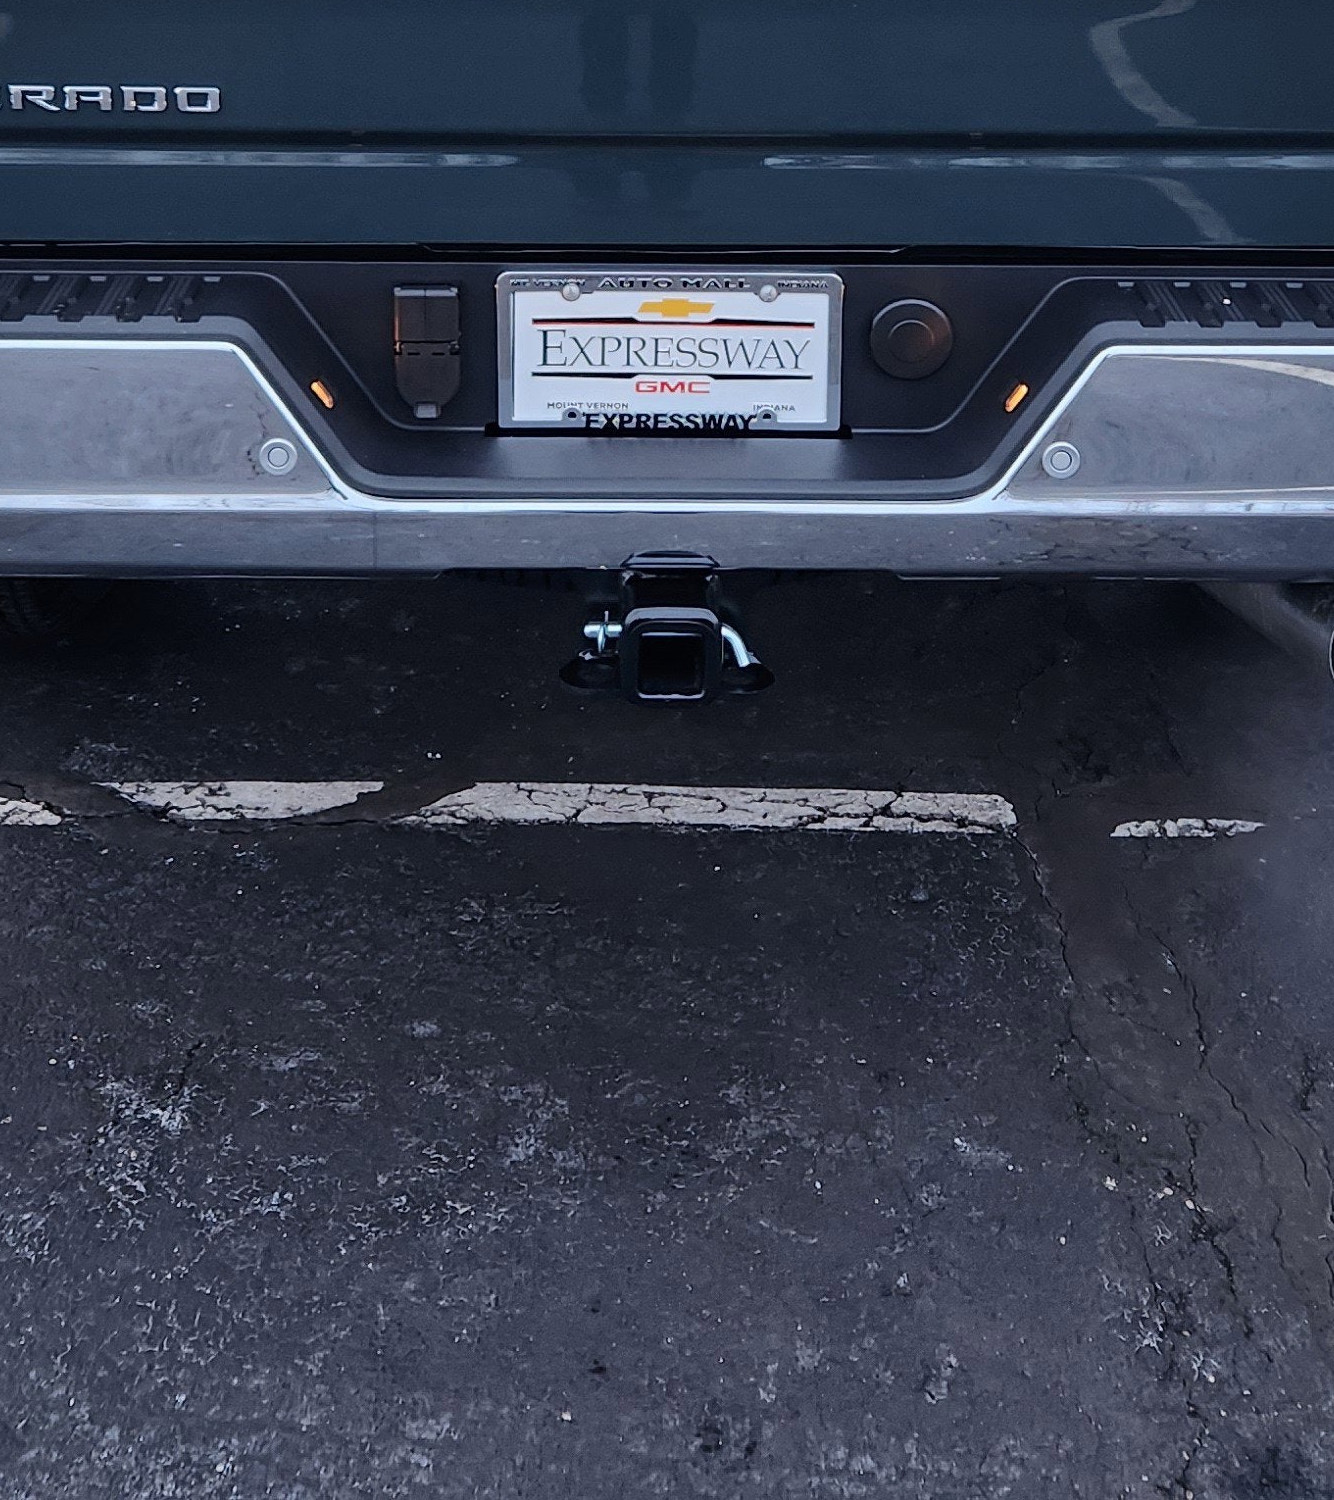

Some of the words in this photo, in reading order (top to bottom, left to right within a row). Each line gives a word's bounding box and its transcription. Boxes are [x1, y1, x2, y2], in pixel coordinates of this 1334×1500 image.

[597, 277, 673, 288] AUTO
[680, 277, 751, 288] MALL
[777, 279, 829, 288] INDIANA
[536, 329, 811, 369] EXPRESSWAY
[635, 381, 711, 393] GMC
[584, 413, 757, 430] EXPRESSWAY
